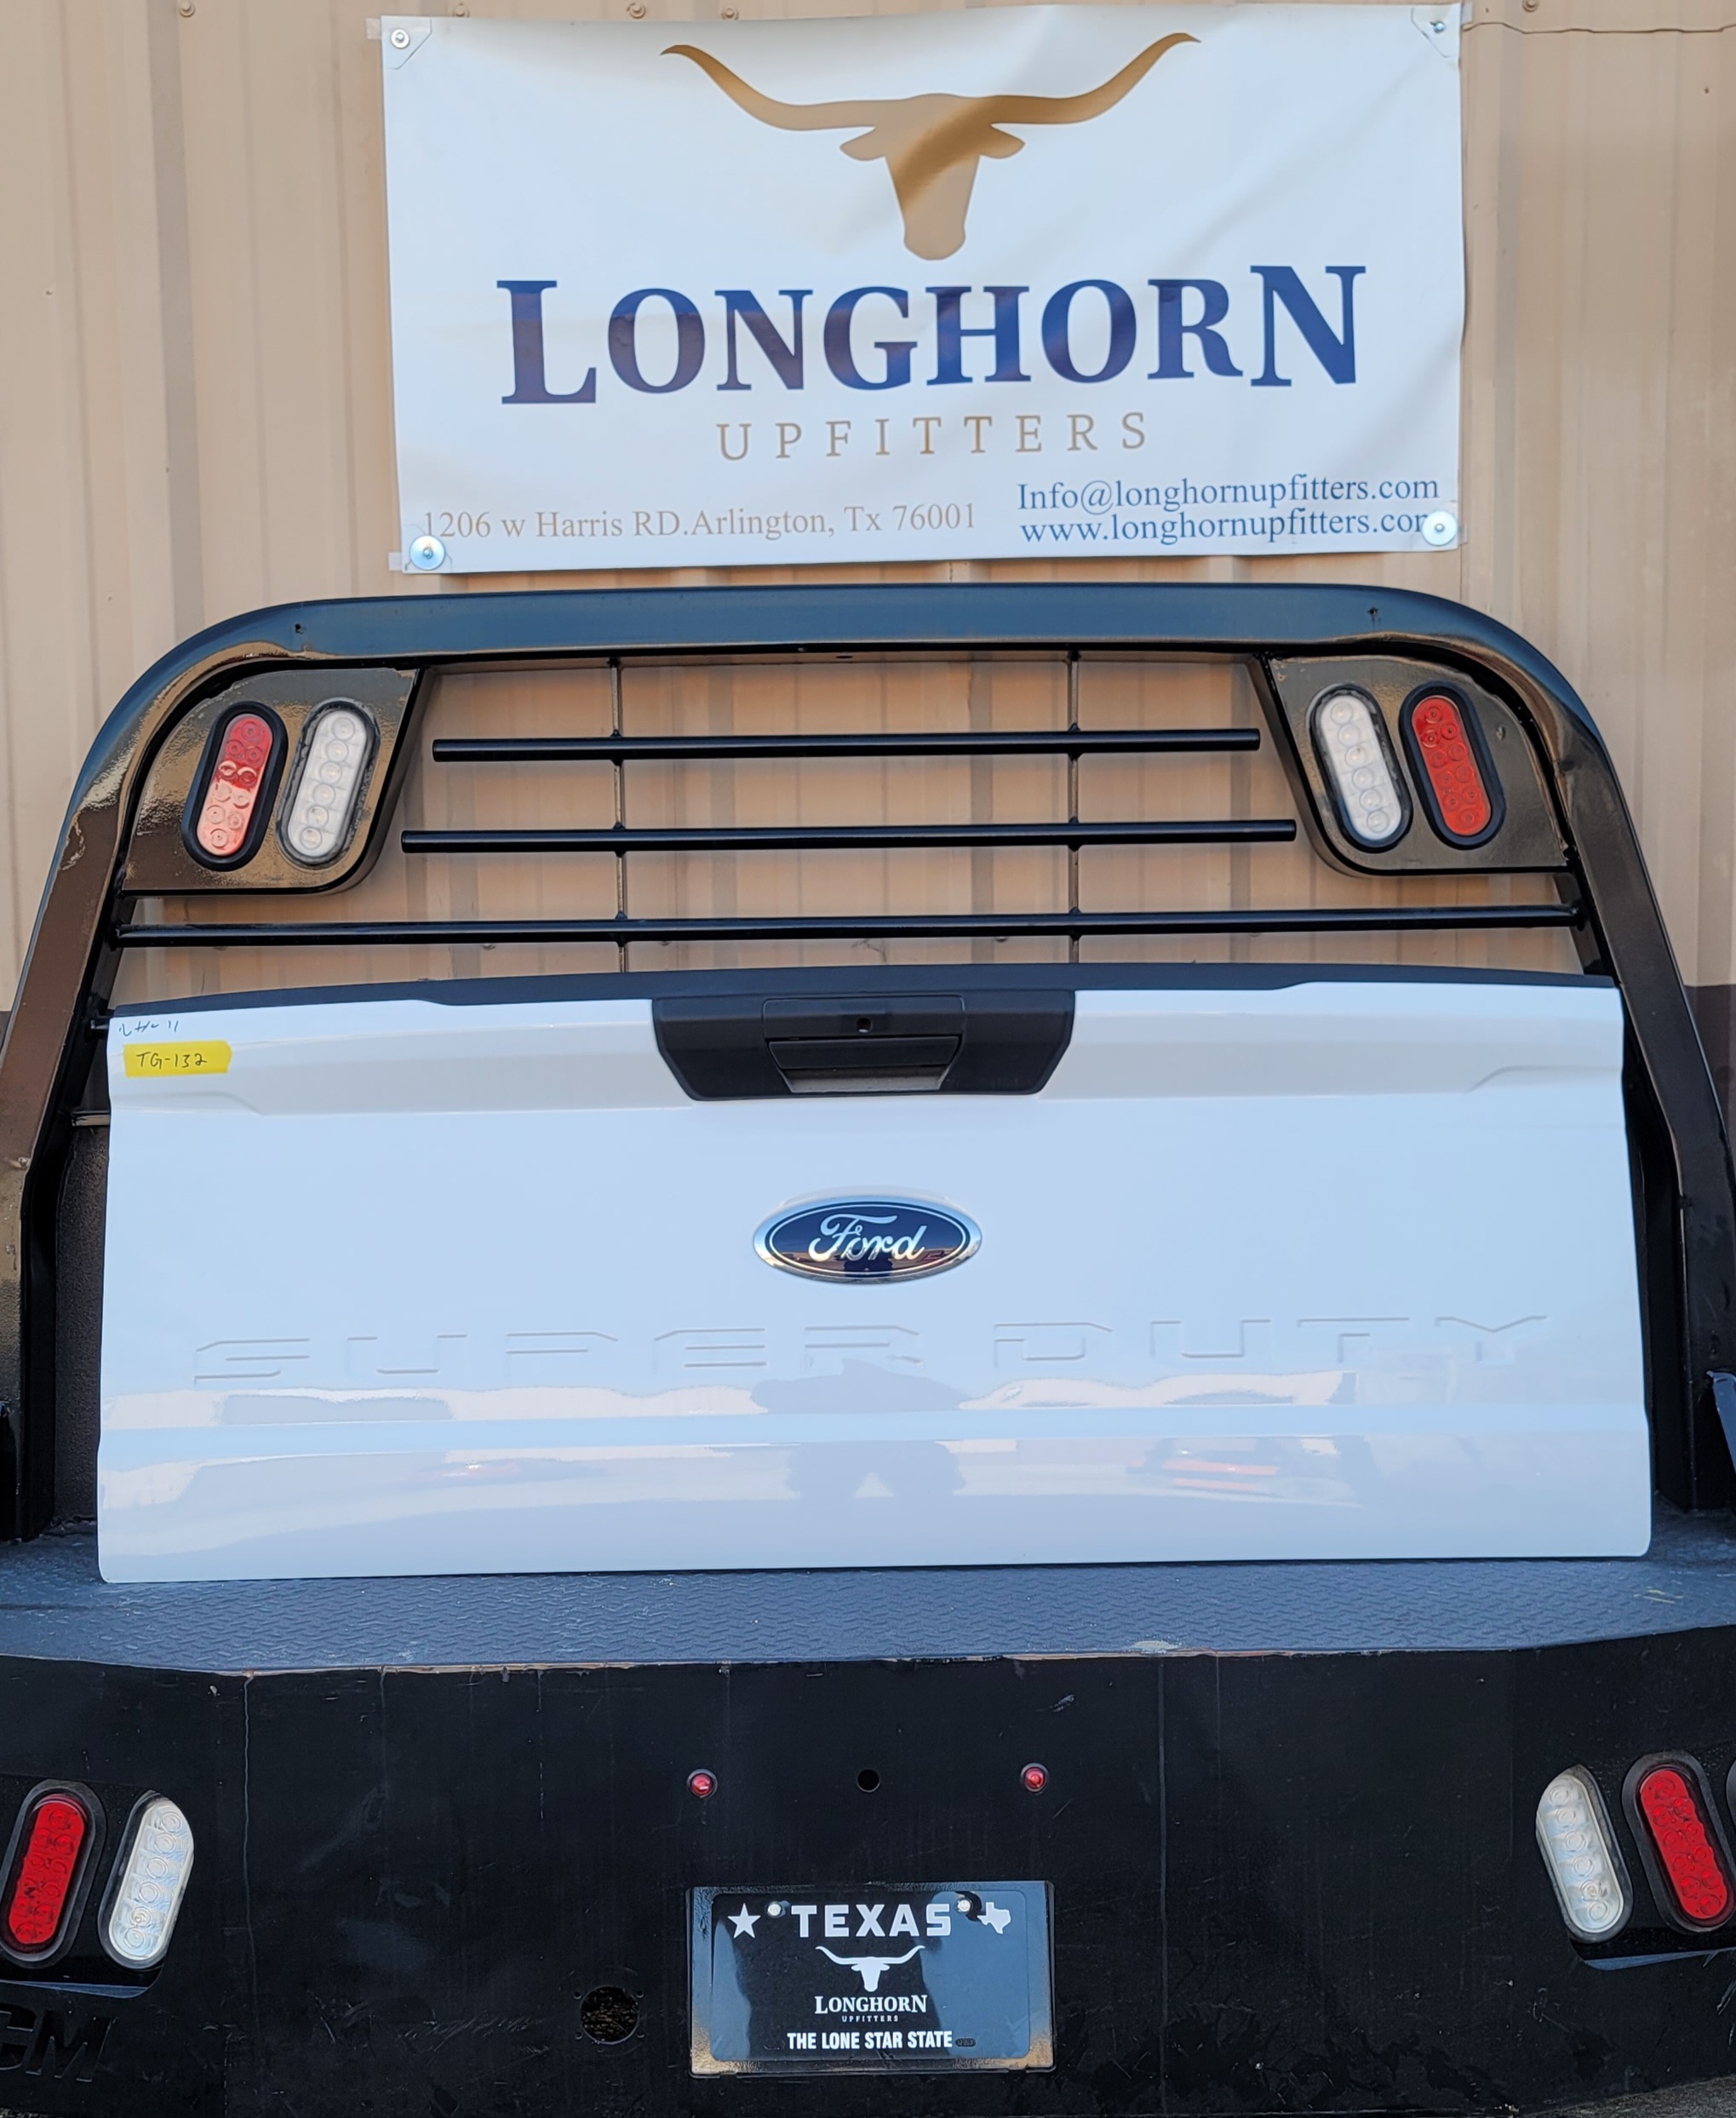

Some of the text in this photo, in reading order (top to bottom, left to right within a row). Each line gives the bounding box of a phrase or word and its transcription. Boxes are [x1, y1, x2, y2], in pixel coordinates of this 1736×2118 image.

[496, 265, 1366, 405] LONGHORN
[716, 411, 1147, 461] UPFITTERS
[1017, 474, 1440, 515] Info@longhornupfitters.com
[424, 511, 491, 538] 1206
[535, 510, 623, 537] Harris
[844, 506, 883, 531] Tx
[892, 502, 975, 531] 76001
[136, 1051, 208, 1070] TG-132
[808, 1213, 928, 1261] Ford
[193, 1315, 1548, 1385] SUPER DUTY
[790, 1903, 952, 1938] TEXAS
[814, 1995, 928, 2015] LONGHORN
[787, 2030, 953, 2049] THE LONE STAR STATE
